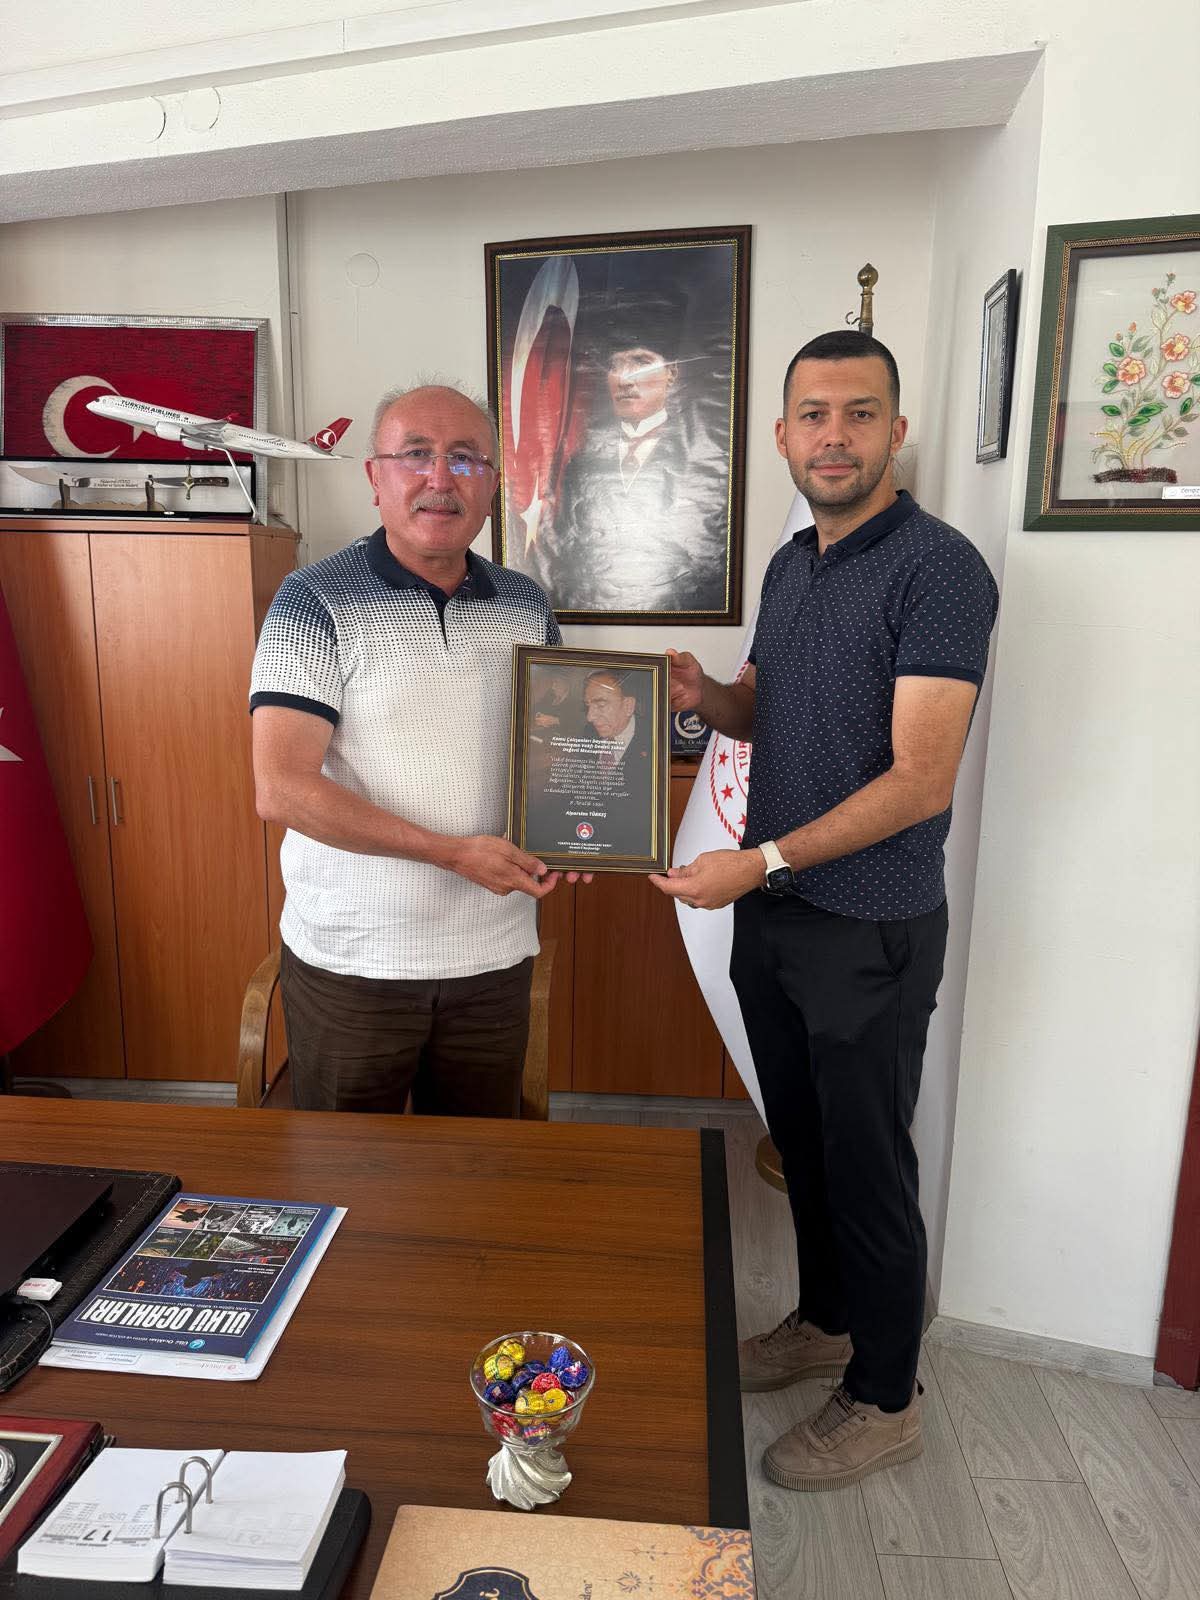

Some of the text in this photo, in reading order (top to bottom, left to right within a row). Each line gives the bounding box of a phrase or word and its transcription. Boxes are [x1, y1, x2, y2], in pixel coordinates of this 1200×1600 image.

[121, 400, 181, 419] TURKISH AIRLINES
[736, 740, 748, 769] TÜR
[80, 1298, 251, 1335] ÜLKÜ OCAKLARI
[83, 1529, 112, 1541] 17
